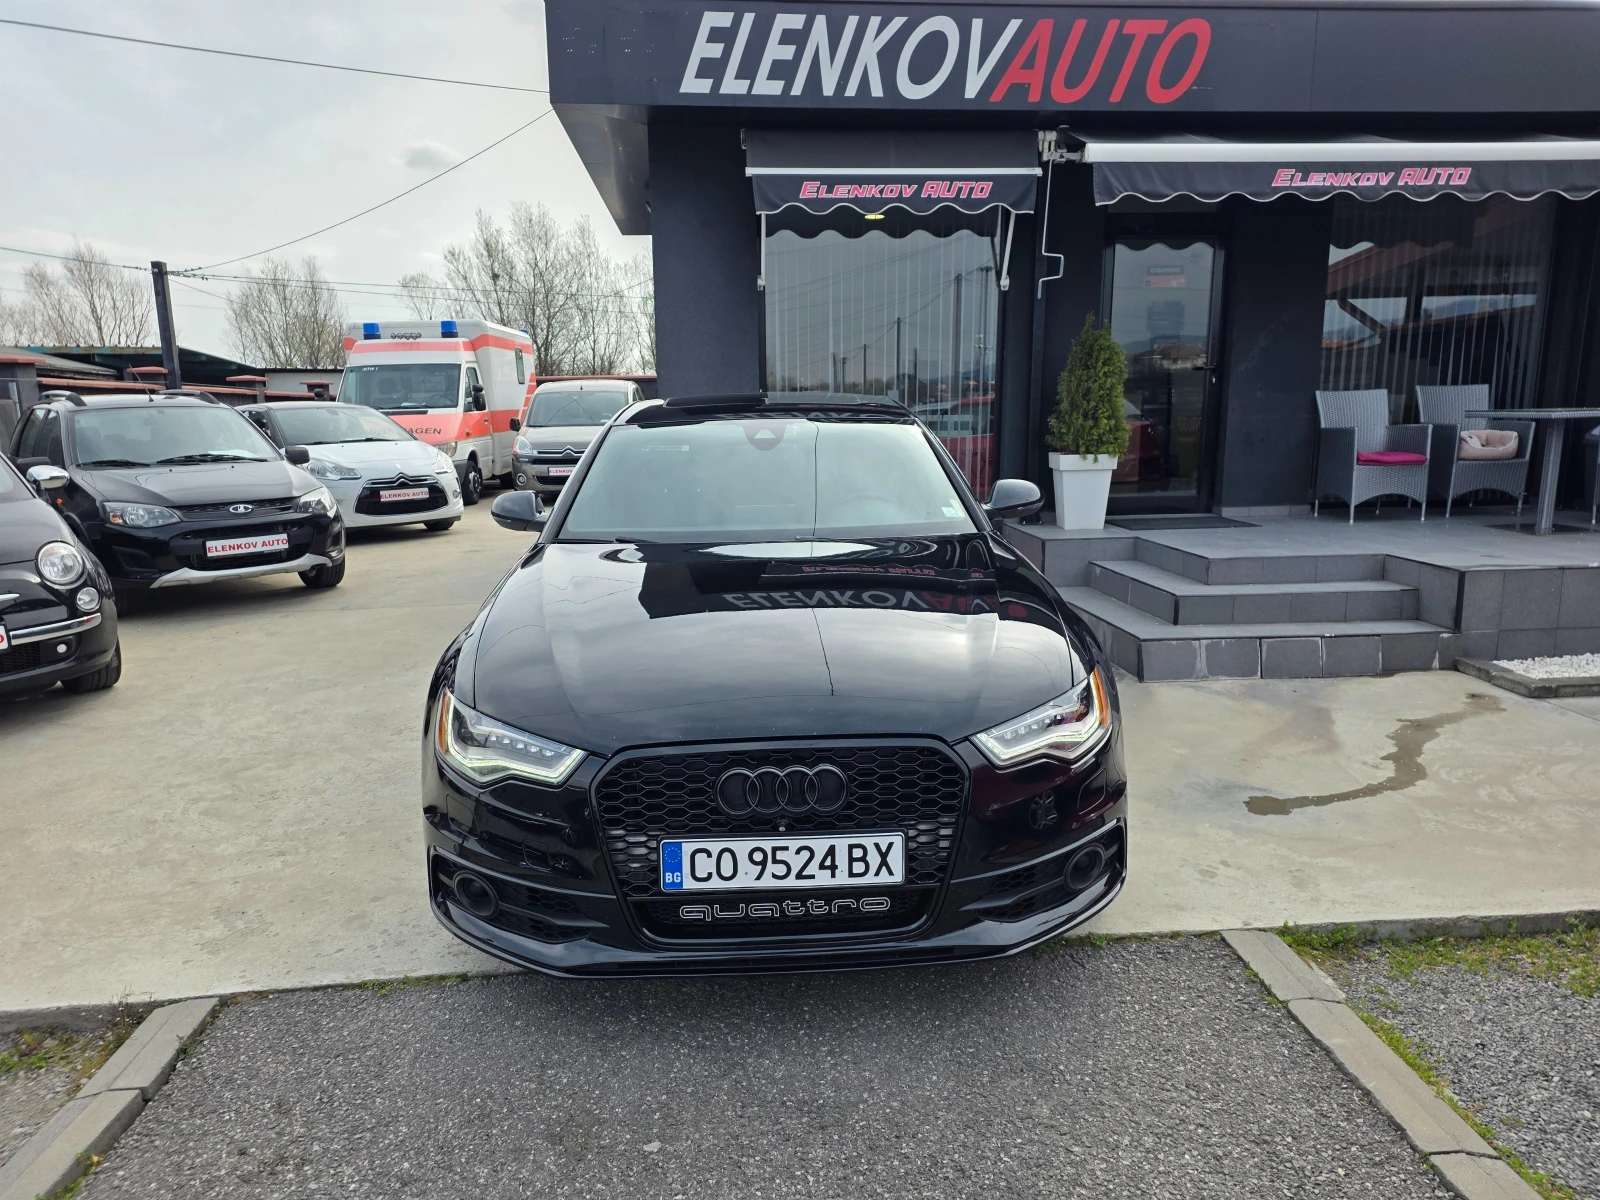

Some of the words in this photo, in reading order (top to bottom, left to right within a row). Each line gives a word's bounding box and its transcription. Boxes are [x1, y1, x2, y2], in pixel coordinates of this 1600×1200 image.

[1271, 169, 1395, 187] ELENKOV
[1397, 167, 1472, 186] AUTO
[799, 181, 919, 199] ELENKOV
[921, 181, 993, 199] AUTO
[380, 492, 411, 500] ELENKOV
[207, 541, 258, 554] ELENKOV
[261, 538, 289, 548] AUTO
[665, 872, 682, 884] BG
[680, 897, 891, 921] quattro
